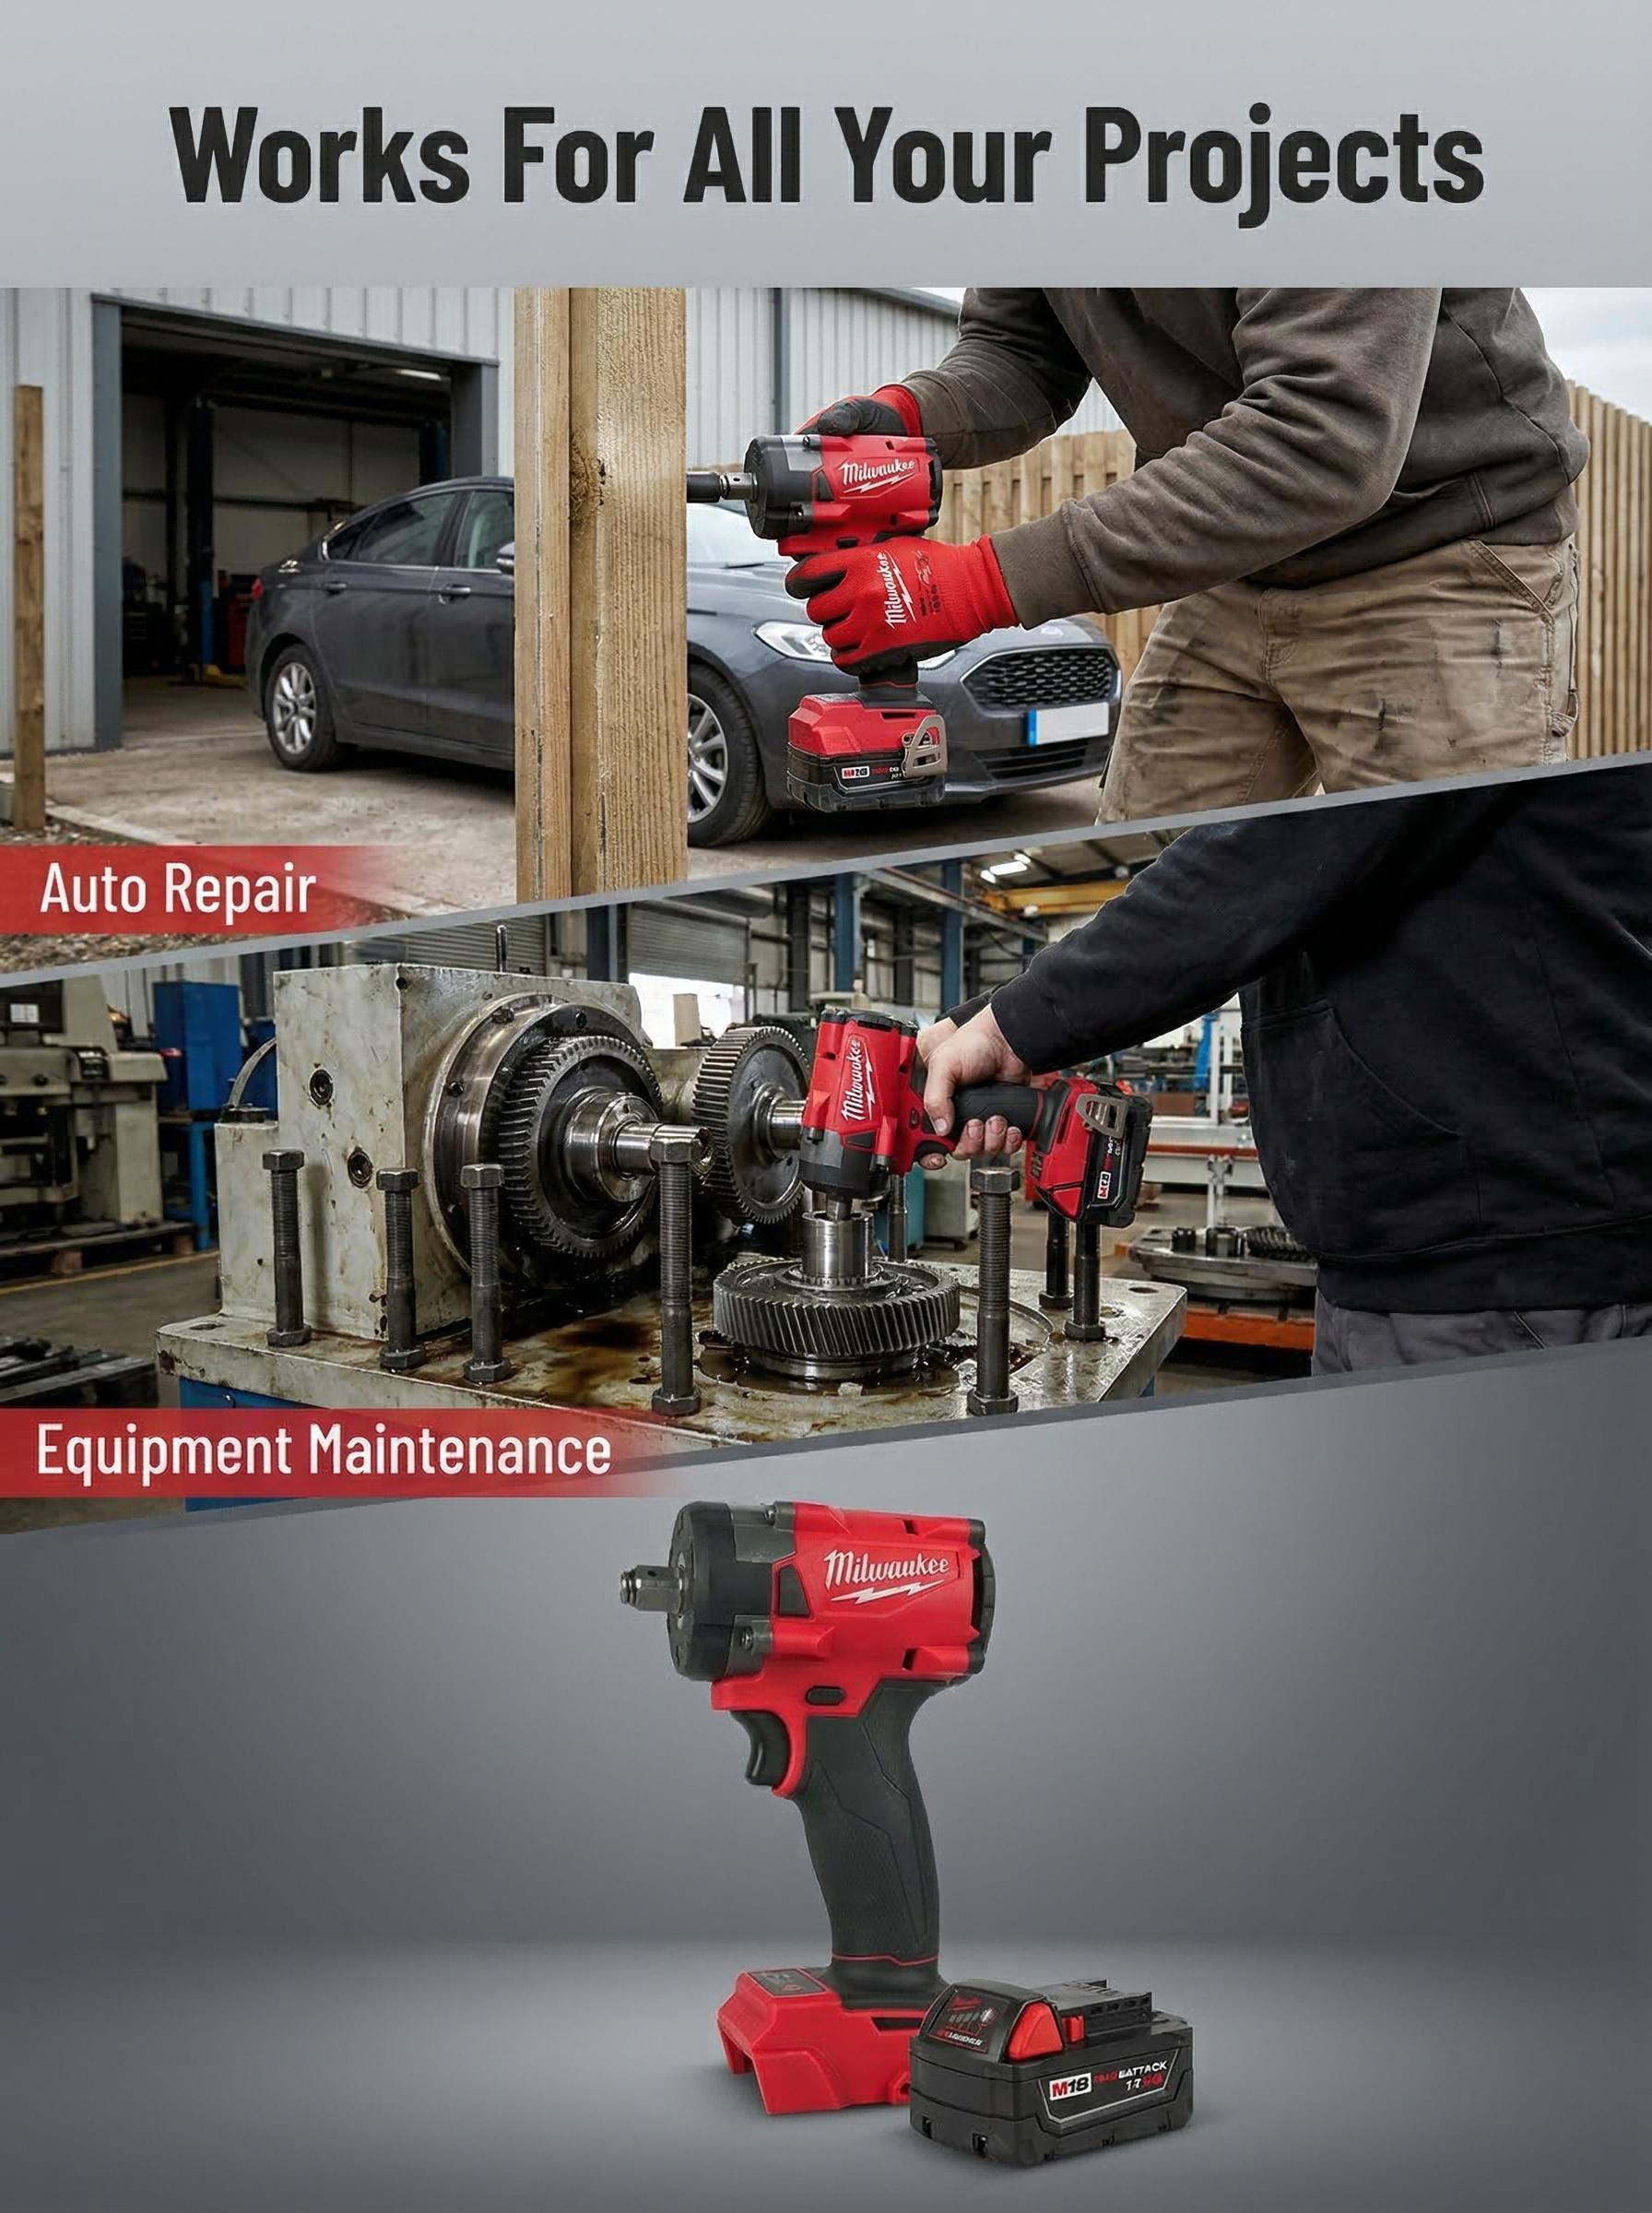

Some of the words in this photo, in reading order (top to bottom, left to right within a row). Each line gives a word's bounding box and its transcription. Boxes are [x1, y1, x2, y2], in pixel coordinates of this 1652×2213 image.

[837, 458, 915, 486] Milwaukee
[823, 1549, 949, 1591] Milwaukee
[1052, 2077, 1090, 2098] M18
